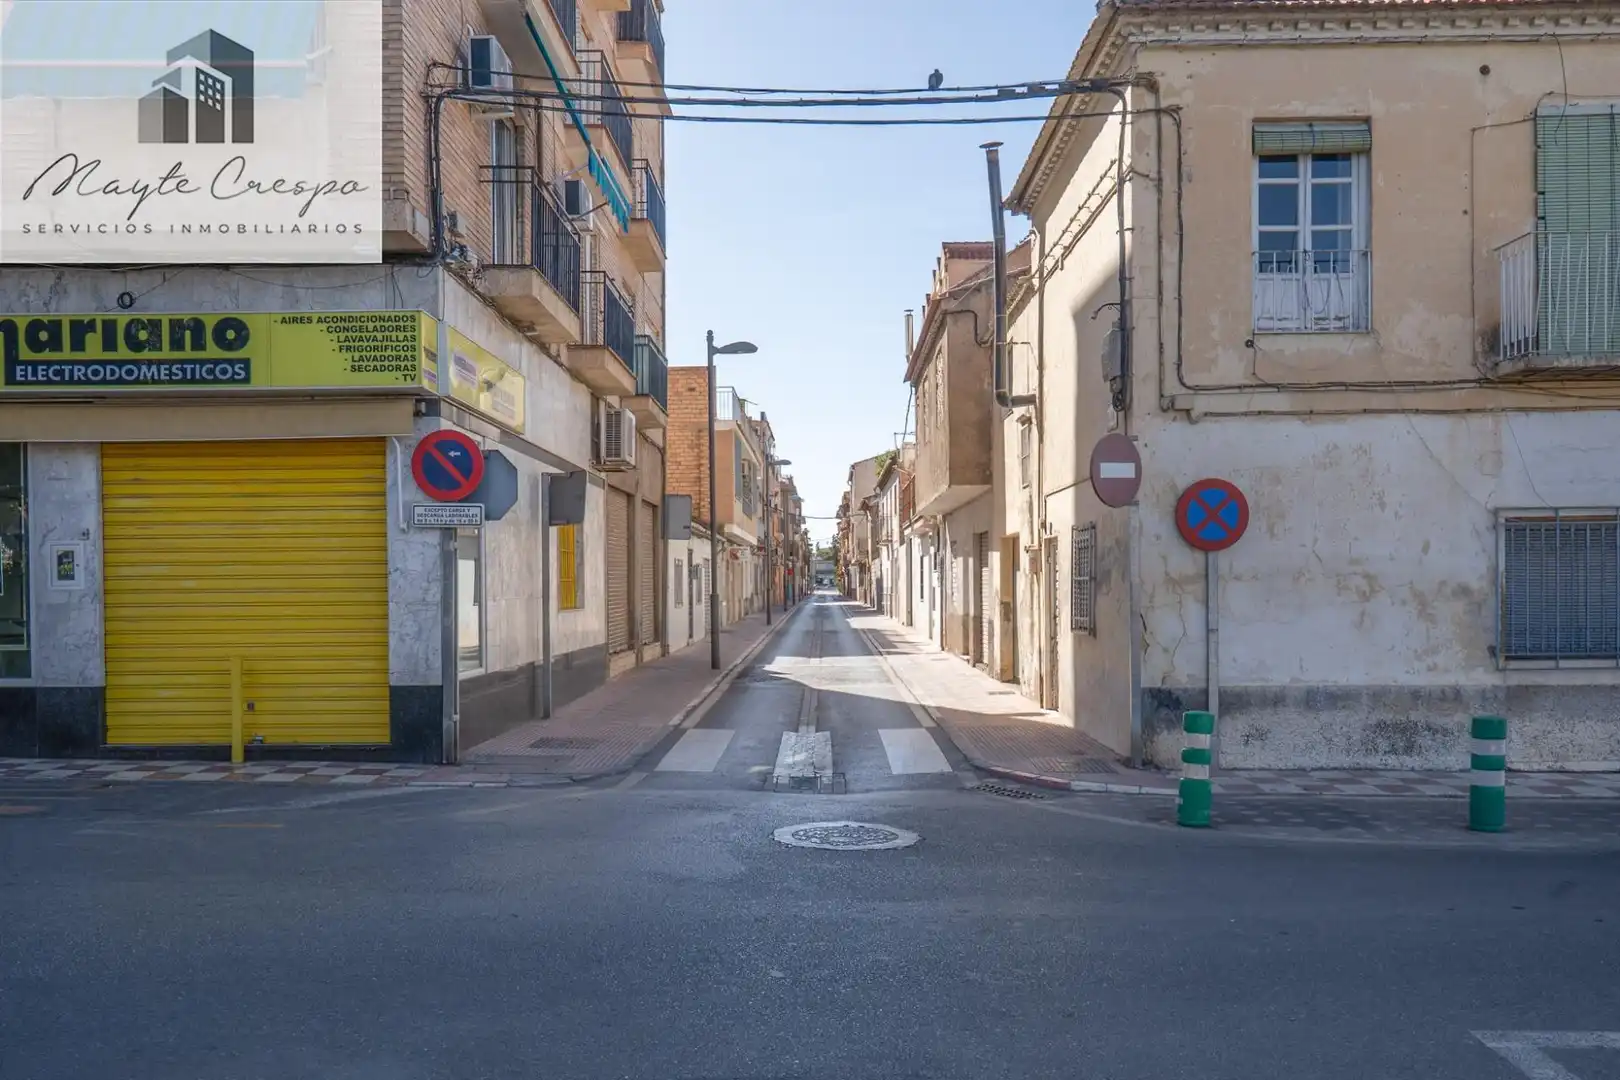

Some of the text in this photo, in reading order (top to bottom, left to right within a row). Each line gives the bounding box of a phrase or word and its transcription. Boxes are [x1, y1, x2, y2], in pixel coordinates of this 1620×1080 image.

[280, 314, 417, 325] AIRES ACONDICIONADOS
[326, 324, 417, 334] CONGELADORES
[336, 334, 417, 344] LAVAVAJILLAS
[351, 354, 417, 363] LAVADORAS
[15, 363, 247, 381] ELECTRODOMESTICOS
[349, 363, 417, 373] SECADORAS
[401, 373, 417, 382] TV
